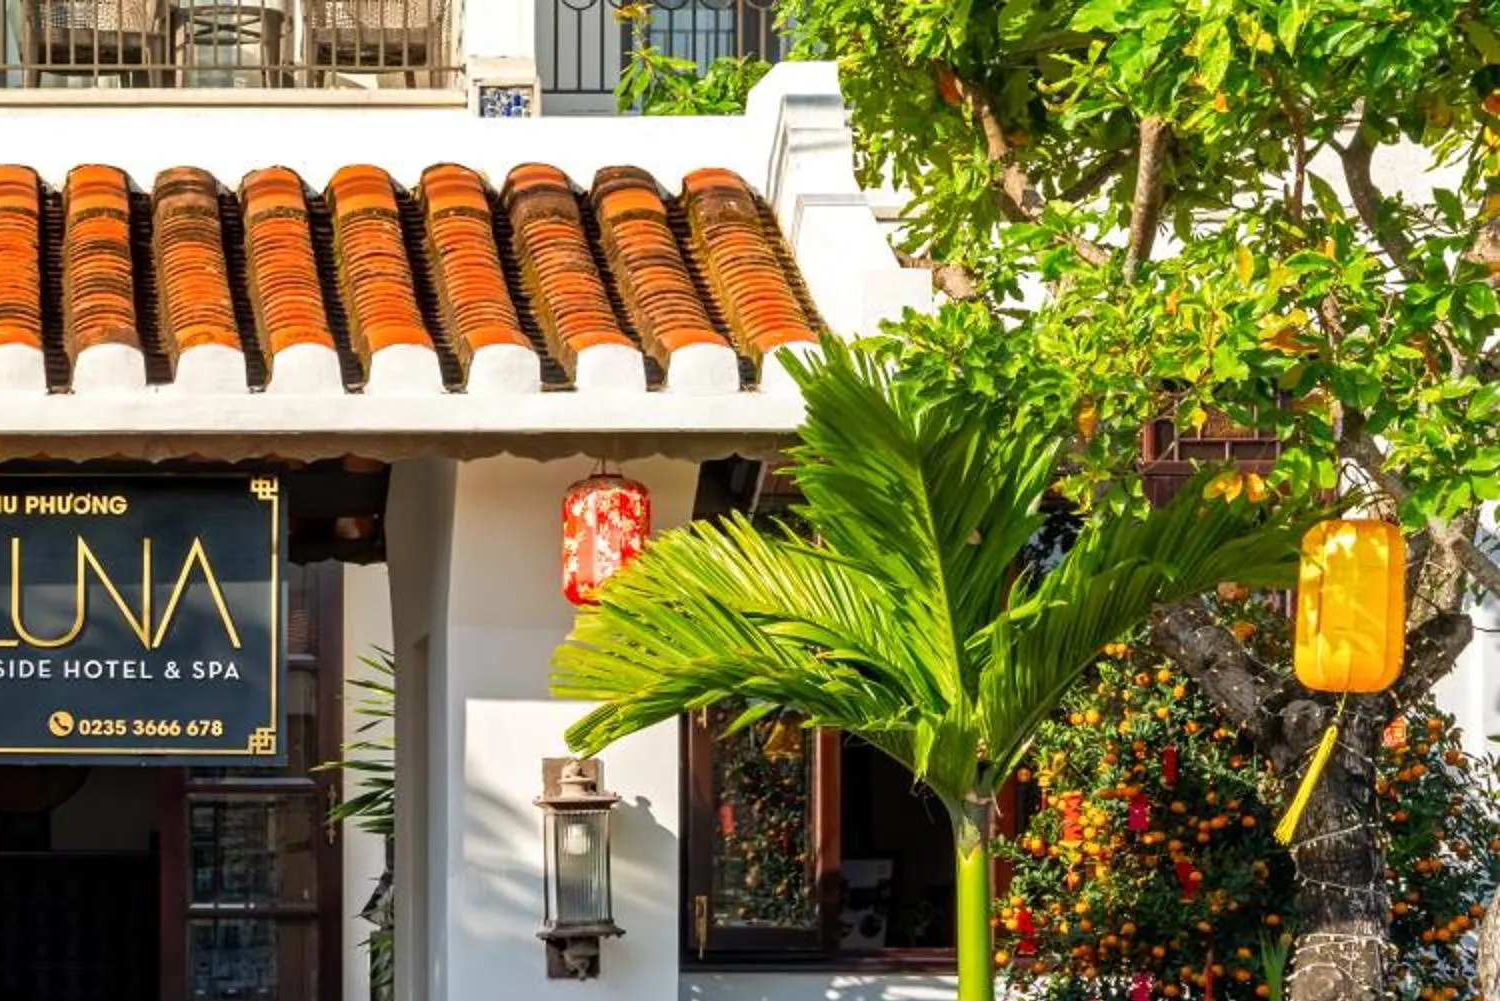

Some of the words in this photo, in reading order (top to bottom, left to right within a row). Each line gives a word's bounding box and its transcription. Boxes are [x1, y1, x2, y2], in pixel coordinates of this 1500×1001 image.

[25, 492, 128, 515] PHƯƠNG
[64, 660, 153, 679] HOTEL
[164, 661, 181, 679] &
[192, 661, 240, 680] SPA
[79, 719, 127, 736] 0235
[132, 720, 181, 737] 3666
[186, 720, 223, 737] 678
